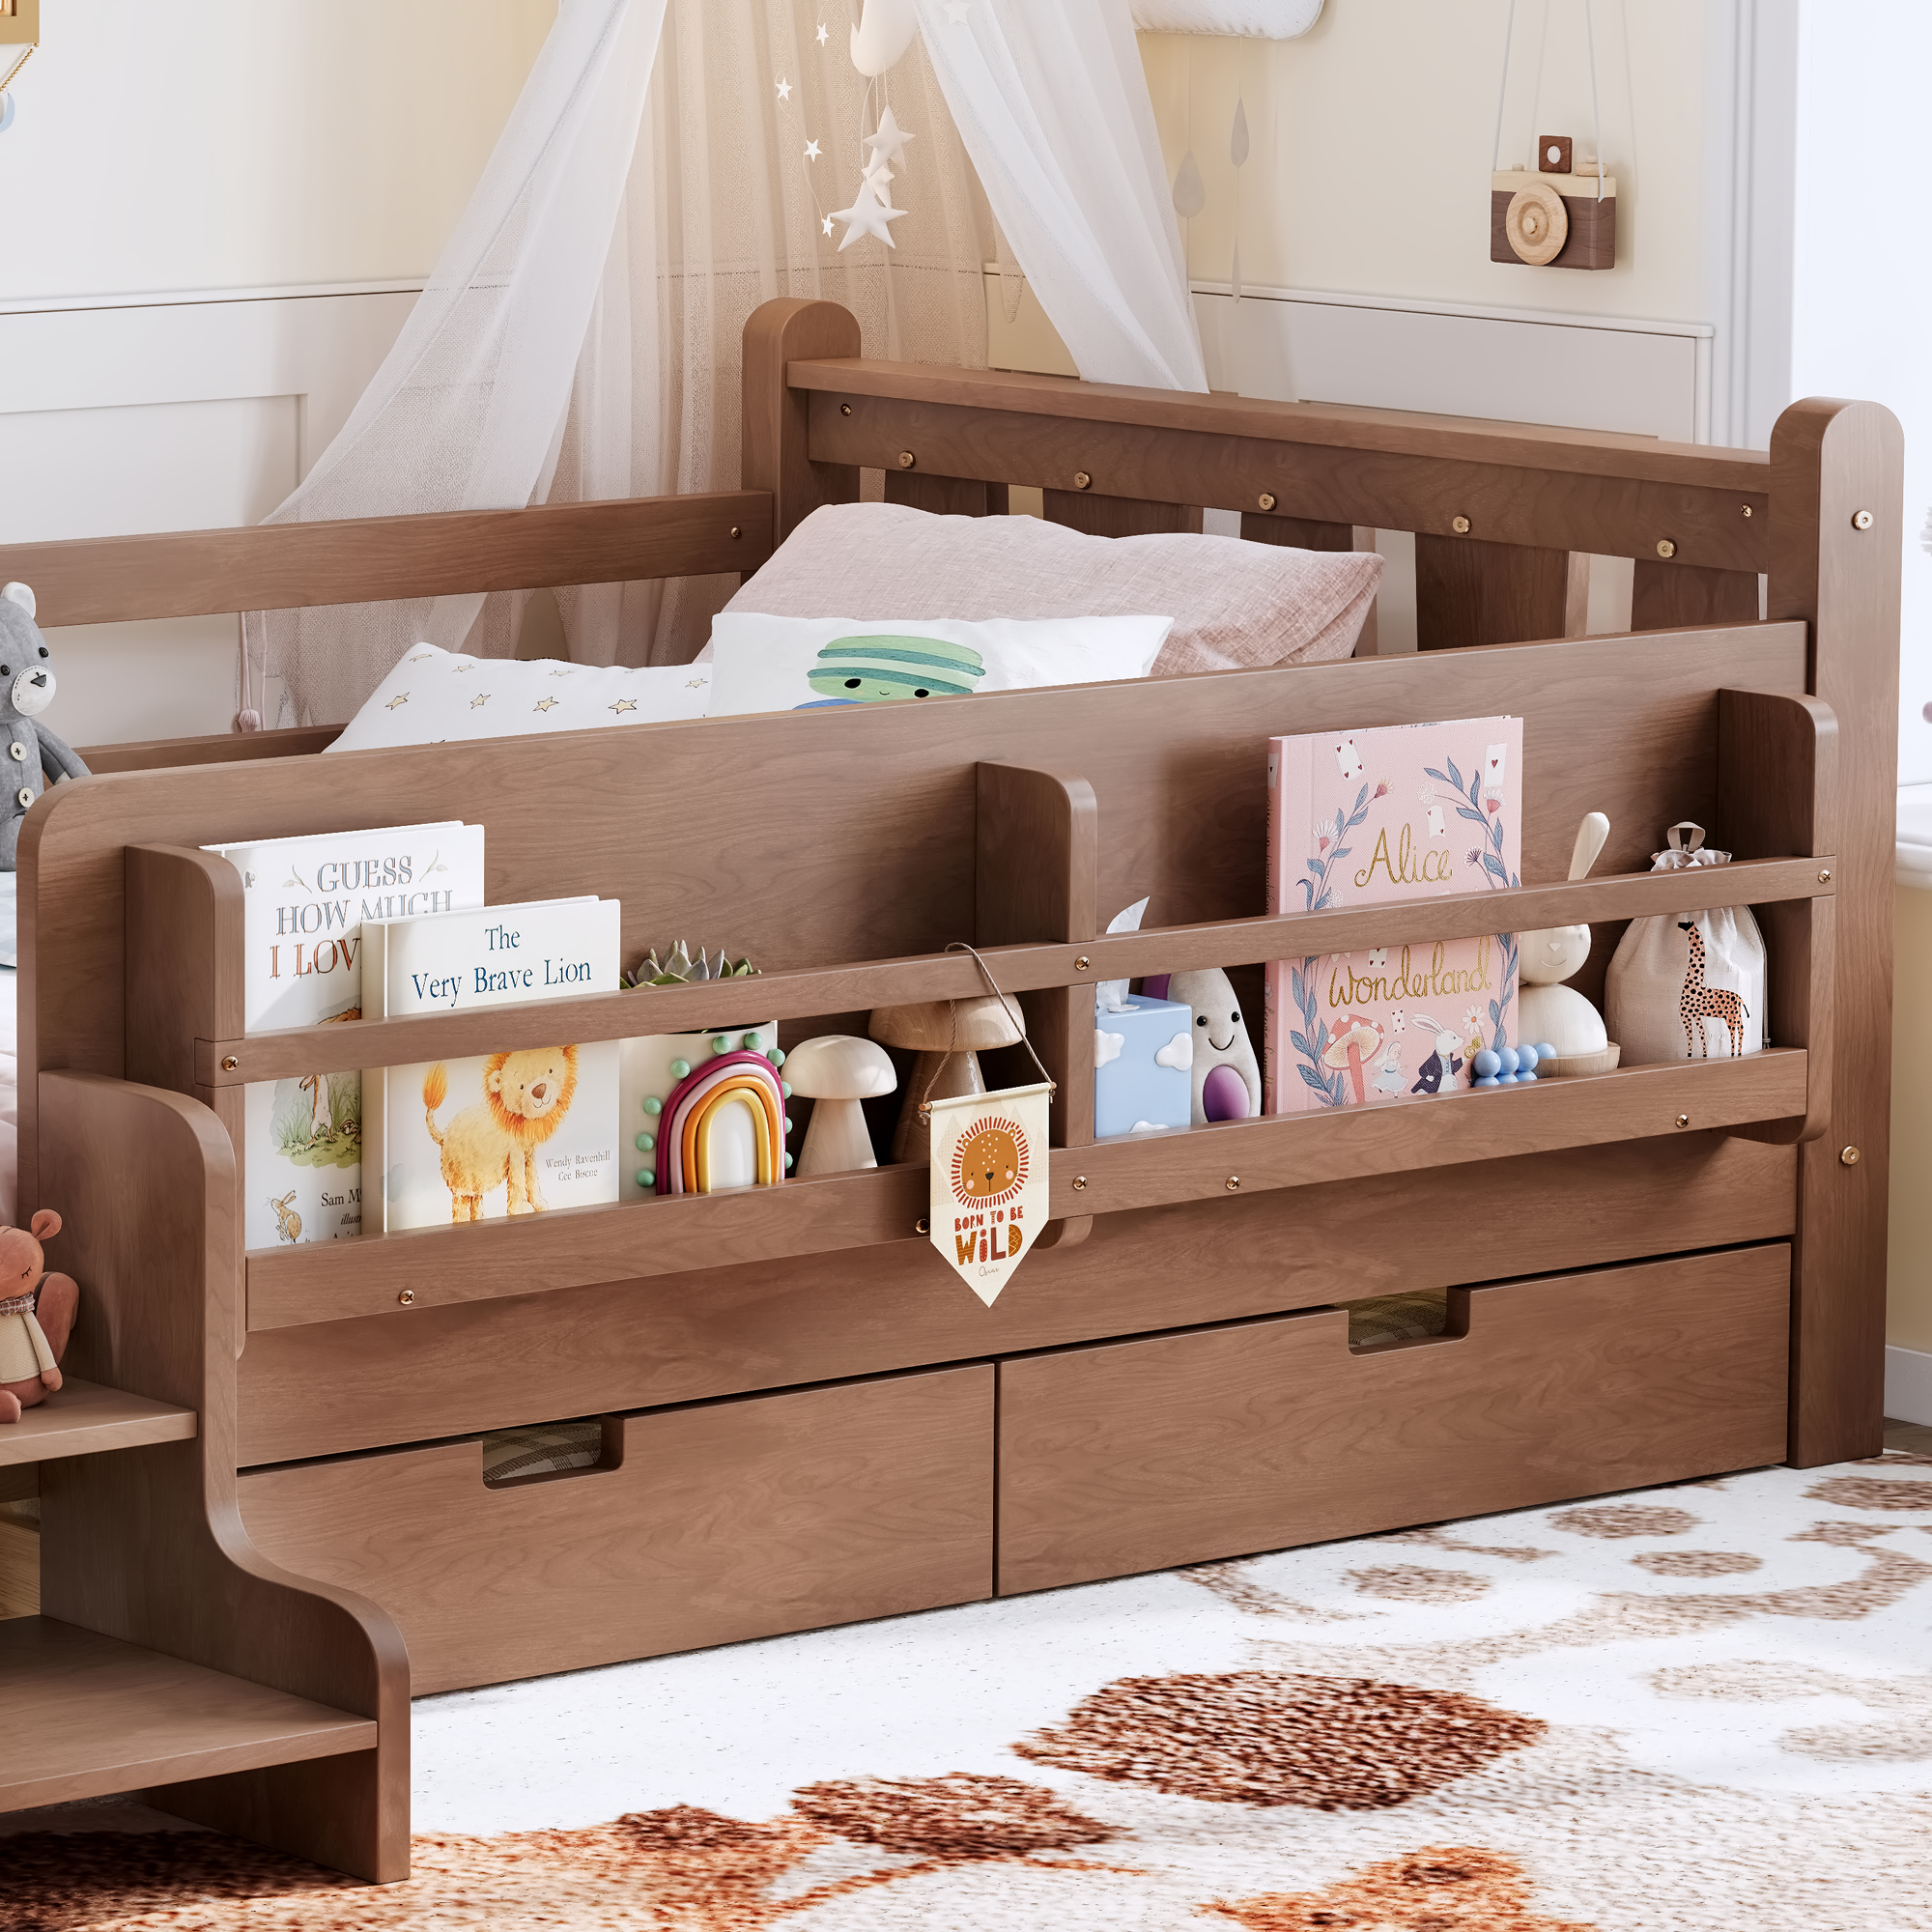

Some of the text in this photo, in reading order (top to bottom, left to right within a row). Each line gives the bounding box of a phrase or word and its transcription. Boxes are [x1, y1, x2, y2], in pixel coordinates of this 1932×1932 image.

[1354, 822, 1452, 887] Alice
[317, 855, 412, 893] GUESS
[276, 890, 453, 936] HOW MUCH
[484, 924, 521, 951] The
[270, 937, 361, 980] I LOV
[1328, 935, 1492, 1009] Wonderland
[412, 957, 592, 1008] Very Brave Lion
[545, 1150, 611, 1170] Wendy Ravenhill
[575, 1169, 598, 1179] Biscoe
[321, 1192, 345, 1208] Sam
[954, 1206, 1024, 1232] BORN TO BE
